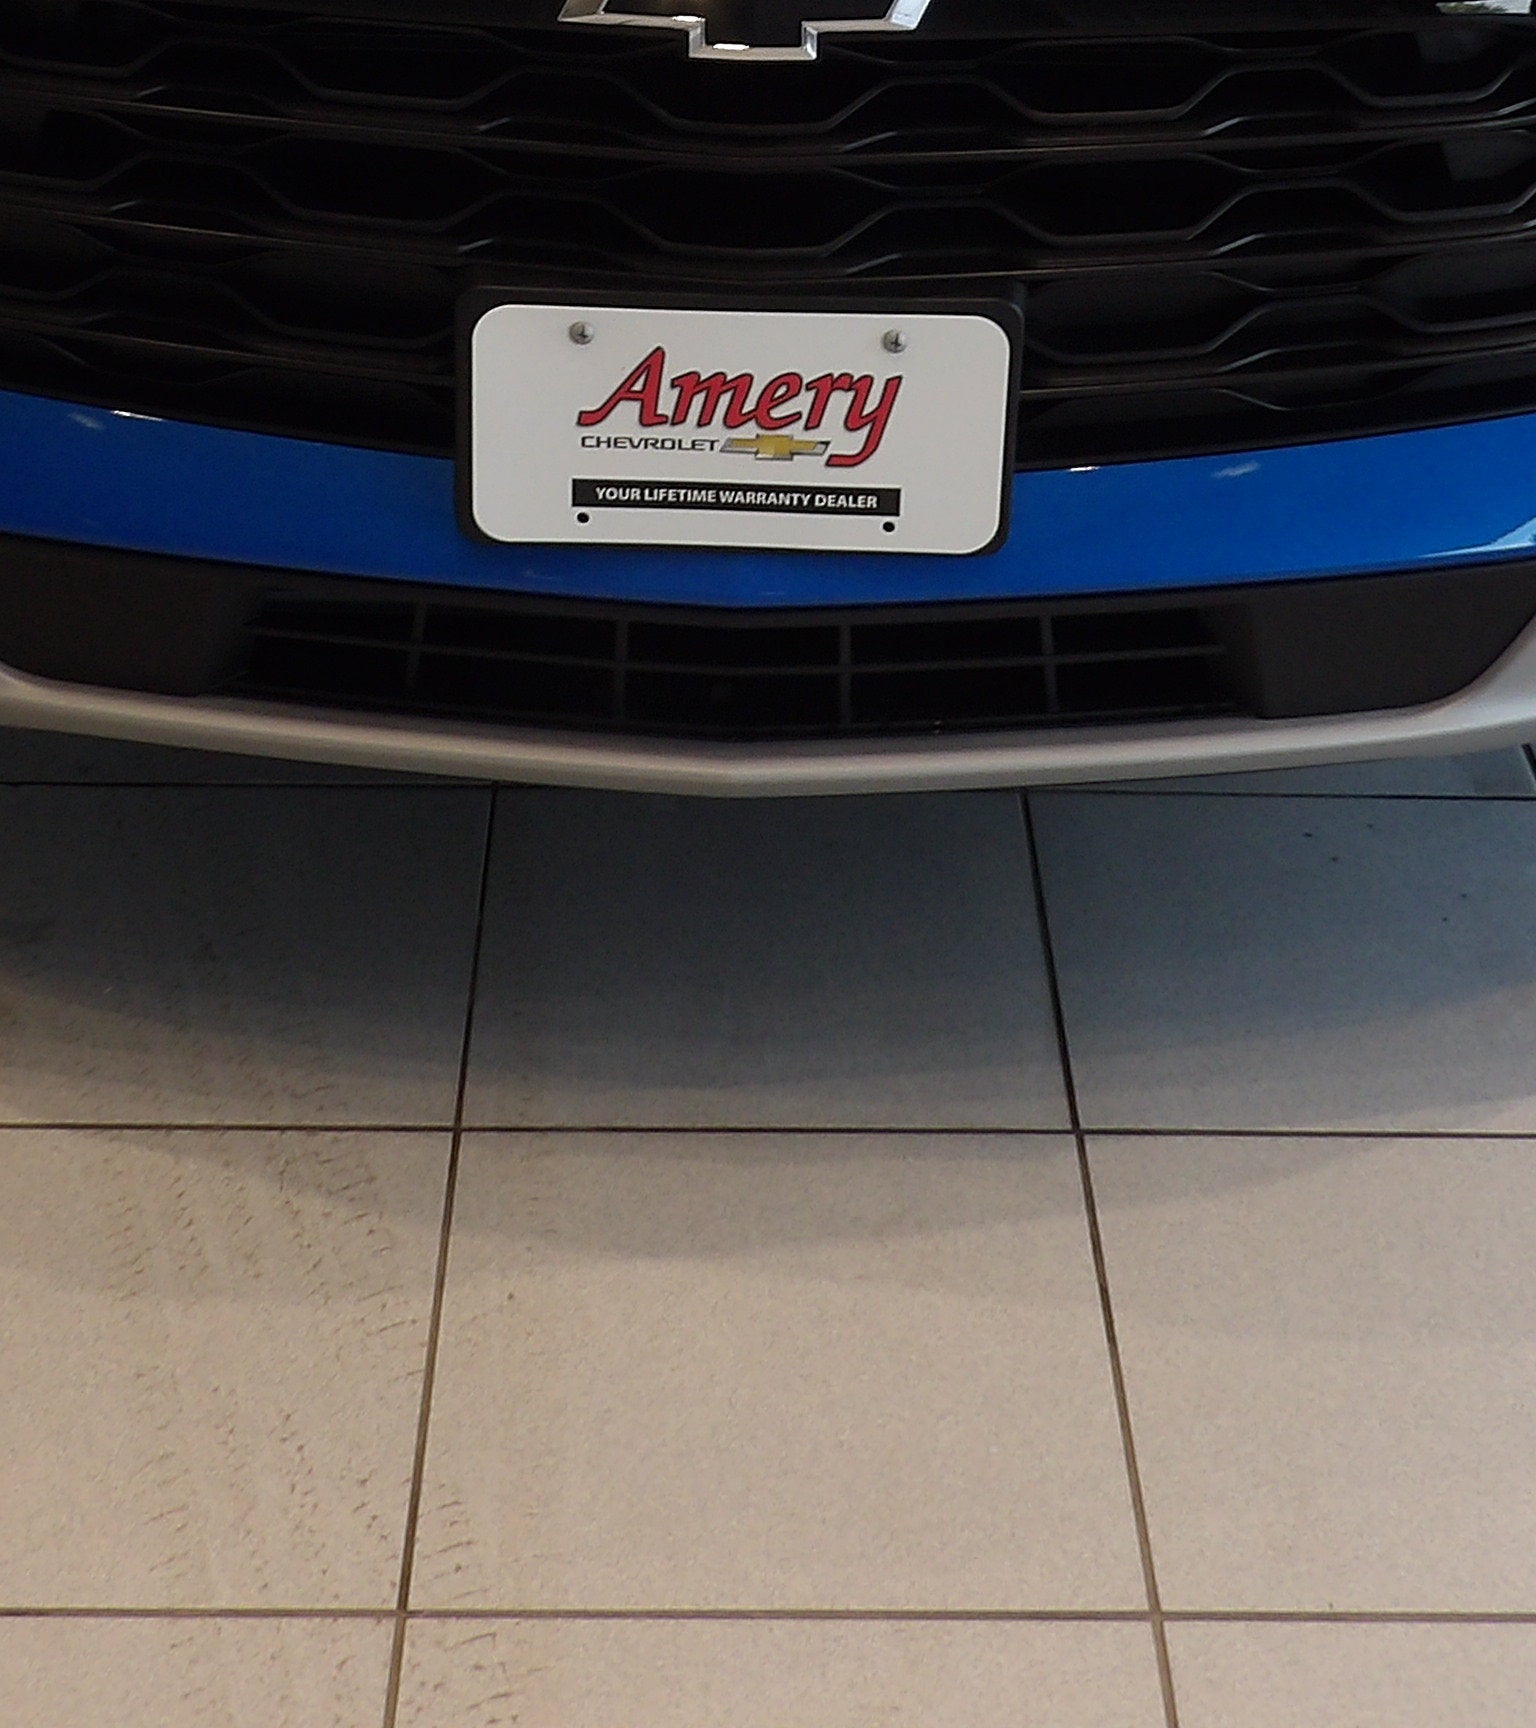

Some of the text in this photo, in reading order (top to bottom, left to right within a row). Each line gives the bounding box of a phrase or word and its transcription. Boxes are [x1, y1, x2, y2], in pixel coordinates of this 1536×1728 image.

[576, 345, 903, 467] Amery
[580, 435, 721, 453] CHEVROLET
[595, 486, 878, 509] YOUR LIFETIME WARRANTY DEALER
